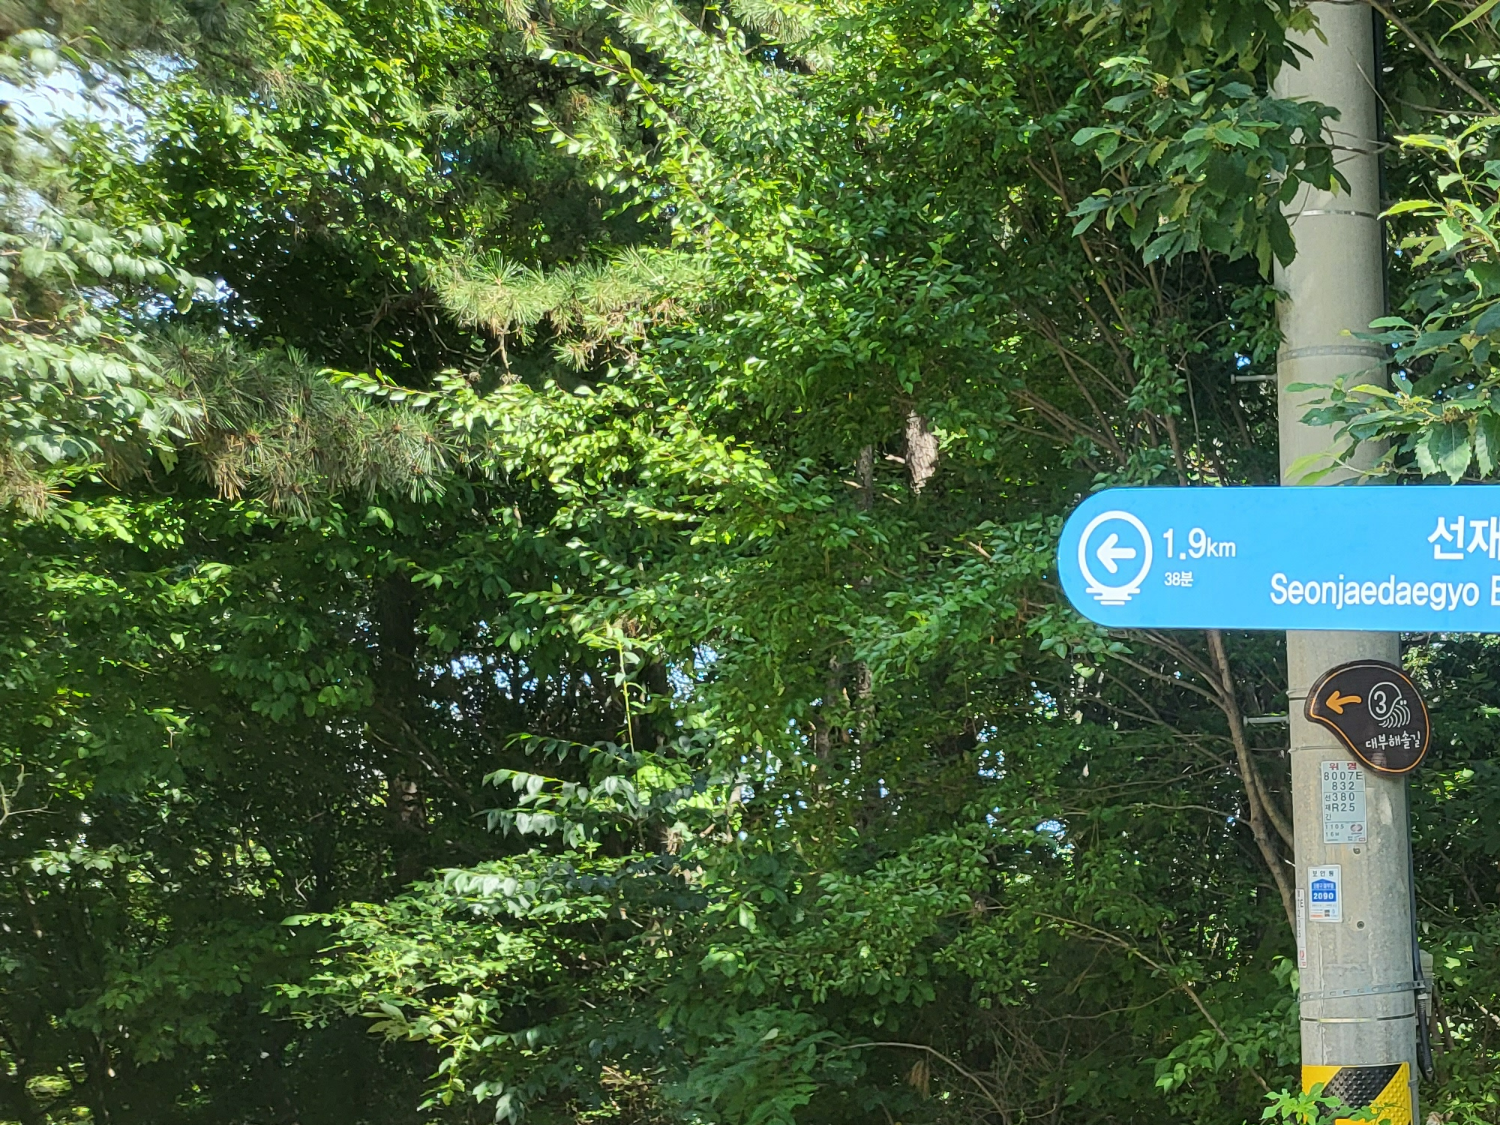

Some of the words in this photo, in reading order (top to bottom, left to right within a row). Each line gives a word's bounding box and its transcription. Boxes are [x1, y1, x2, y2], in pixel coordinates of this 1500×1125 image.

[1162, 527, 1236, 560] 1.9km
[1164, 571, 1194, 588] 38분
[1269, 572, 1480, 612] Seonjaedaegyo
[1372, 690, 1387, 714] 3
[1365, 731, 1421, 750] 대부해솔길
[1332, 781, 1354, 791] 832
[1332, 792, 1355, 802] 380
[1332, 802, 1356, 812] R25
[1314, 892, 1334, 900] 2090
